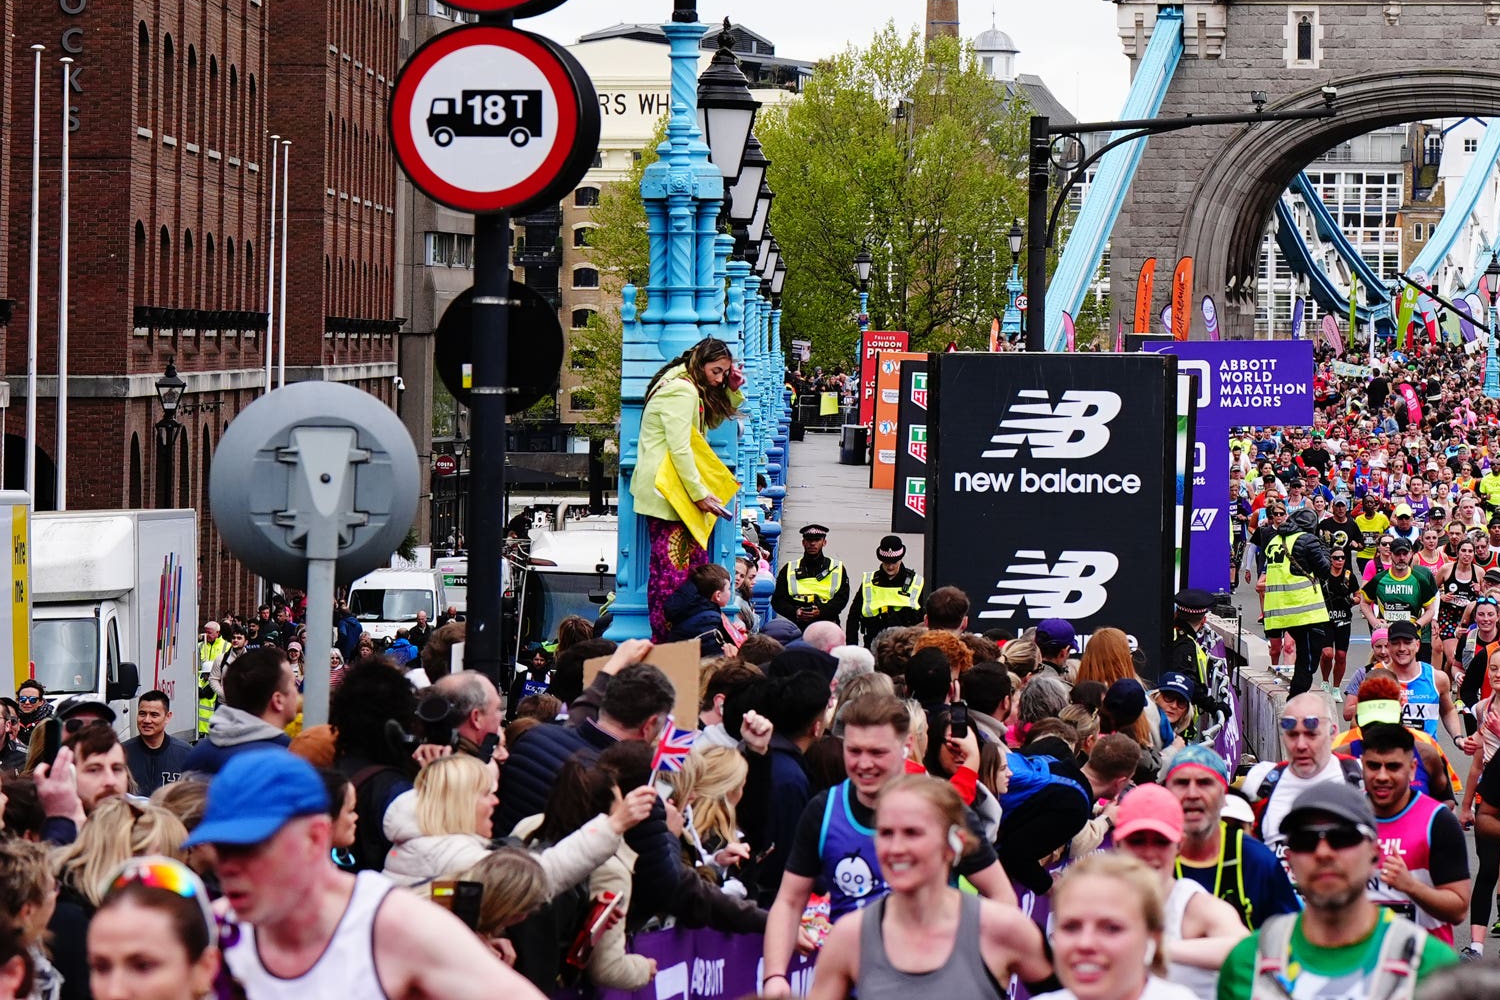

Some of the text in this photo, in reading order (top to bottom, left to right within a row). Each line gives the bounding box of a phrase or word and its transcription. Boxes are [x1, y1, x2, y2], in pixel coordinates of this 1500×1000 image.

[1219, 359, 1278, 371] ABBOTT
[1219, 371, 1273, 383] WORLD
[1220, 383, 1307, 395] MARATHON
[1220, 396, 1282, 407] MAJORS
[954, 468, 1142, 494] new balance
[1384, 584, 1414, 595] MARTIN
